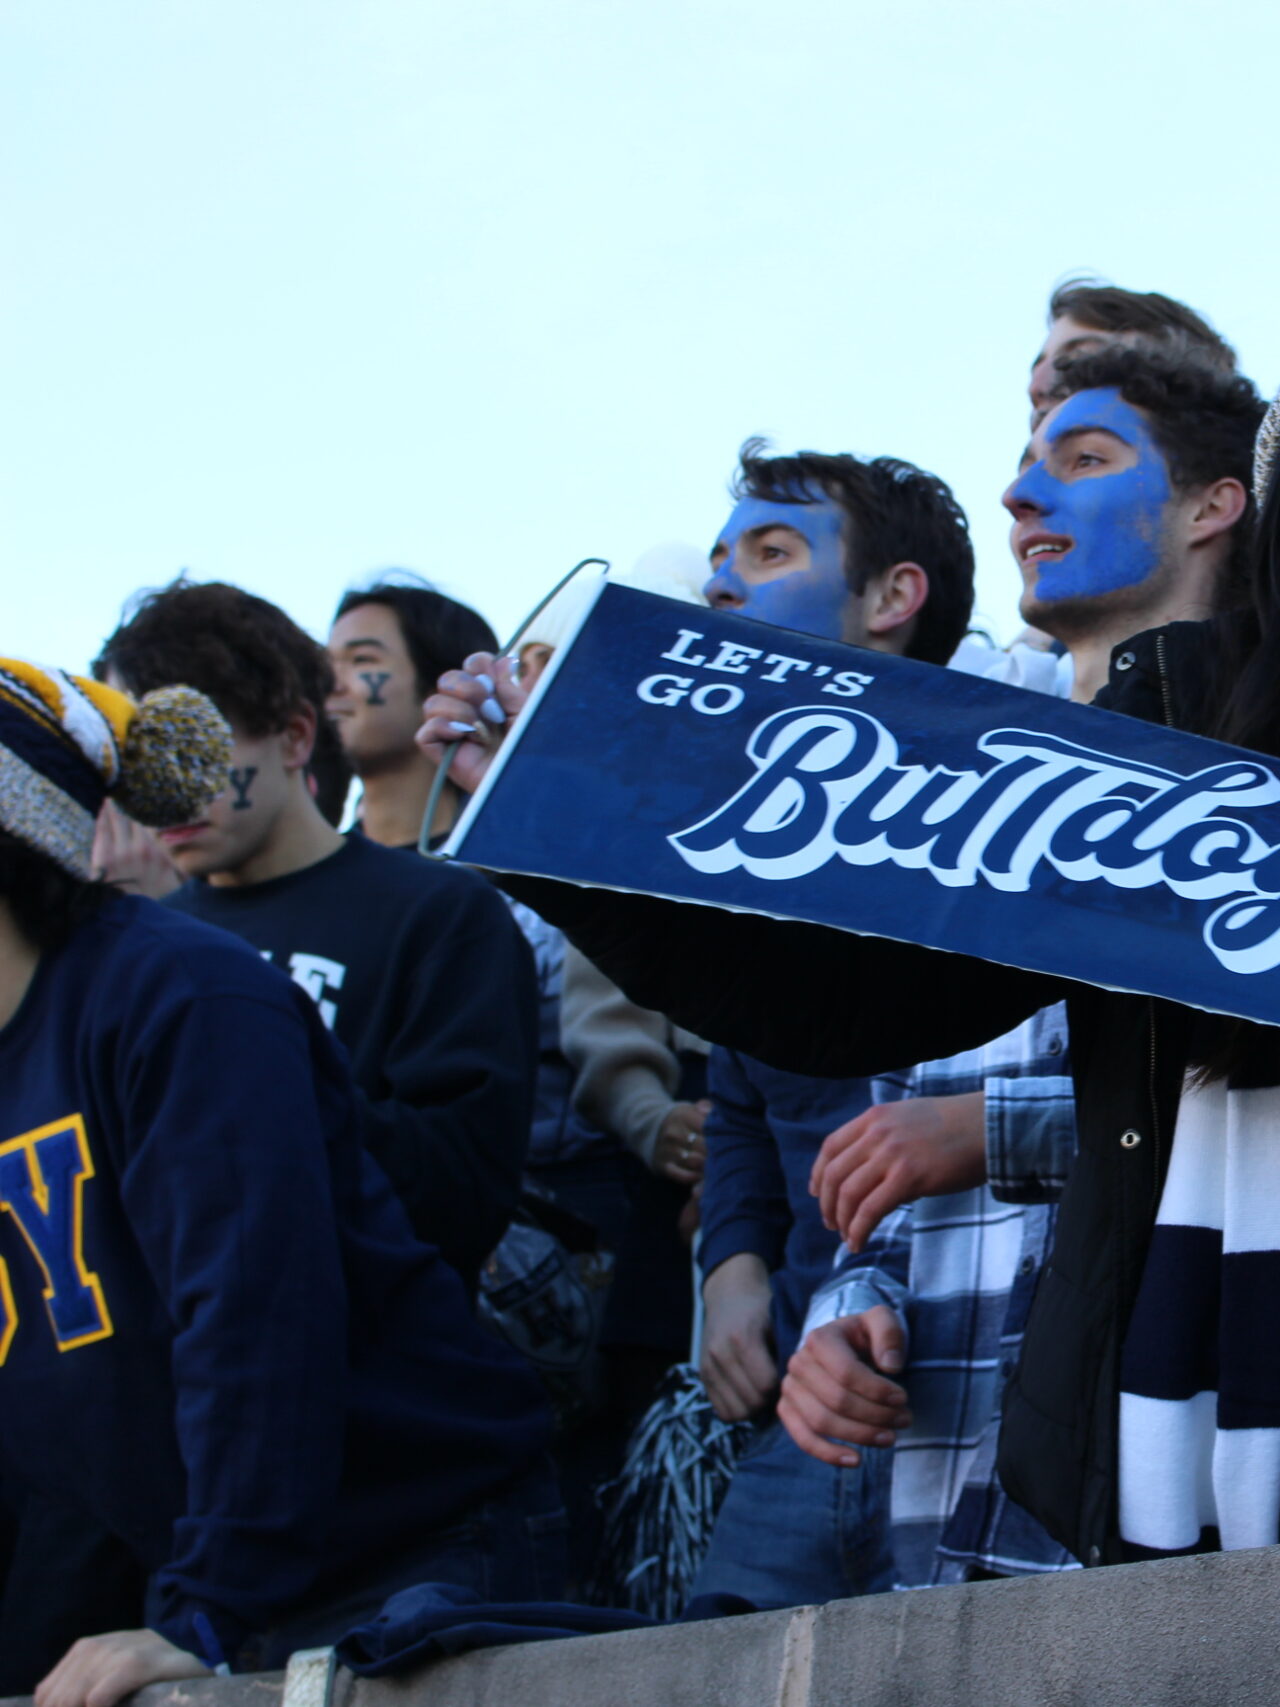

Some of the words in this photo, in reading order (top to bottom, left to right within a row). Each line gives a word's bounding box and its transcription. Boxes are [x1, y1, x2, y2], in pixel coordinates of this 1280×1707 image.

[662, 628, 875, 697] LET'S
[358, 672, 392, 706] Y
[636, 673, 746, 716] GO
[228, 766, 259, 811] Y
[0, 1112, 114, 1366] Y
